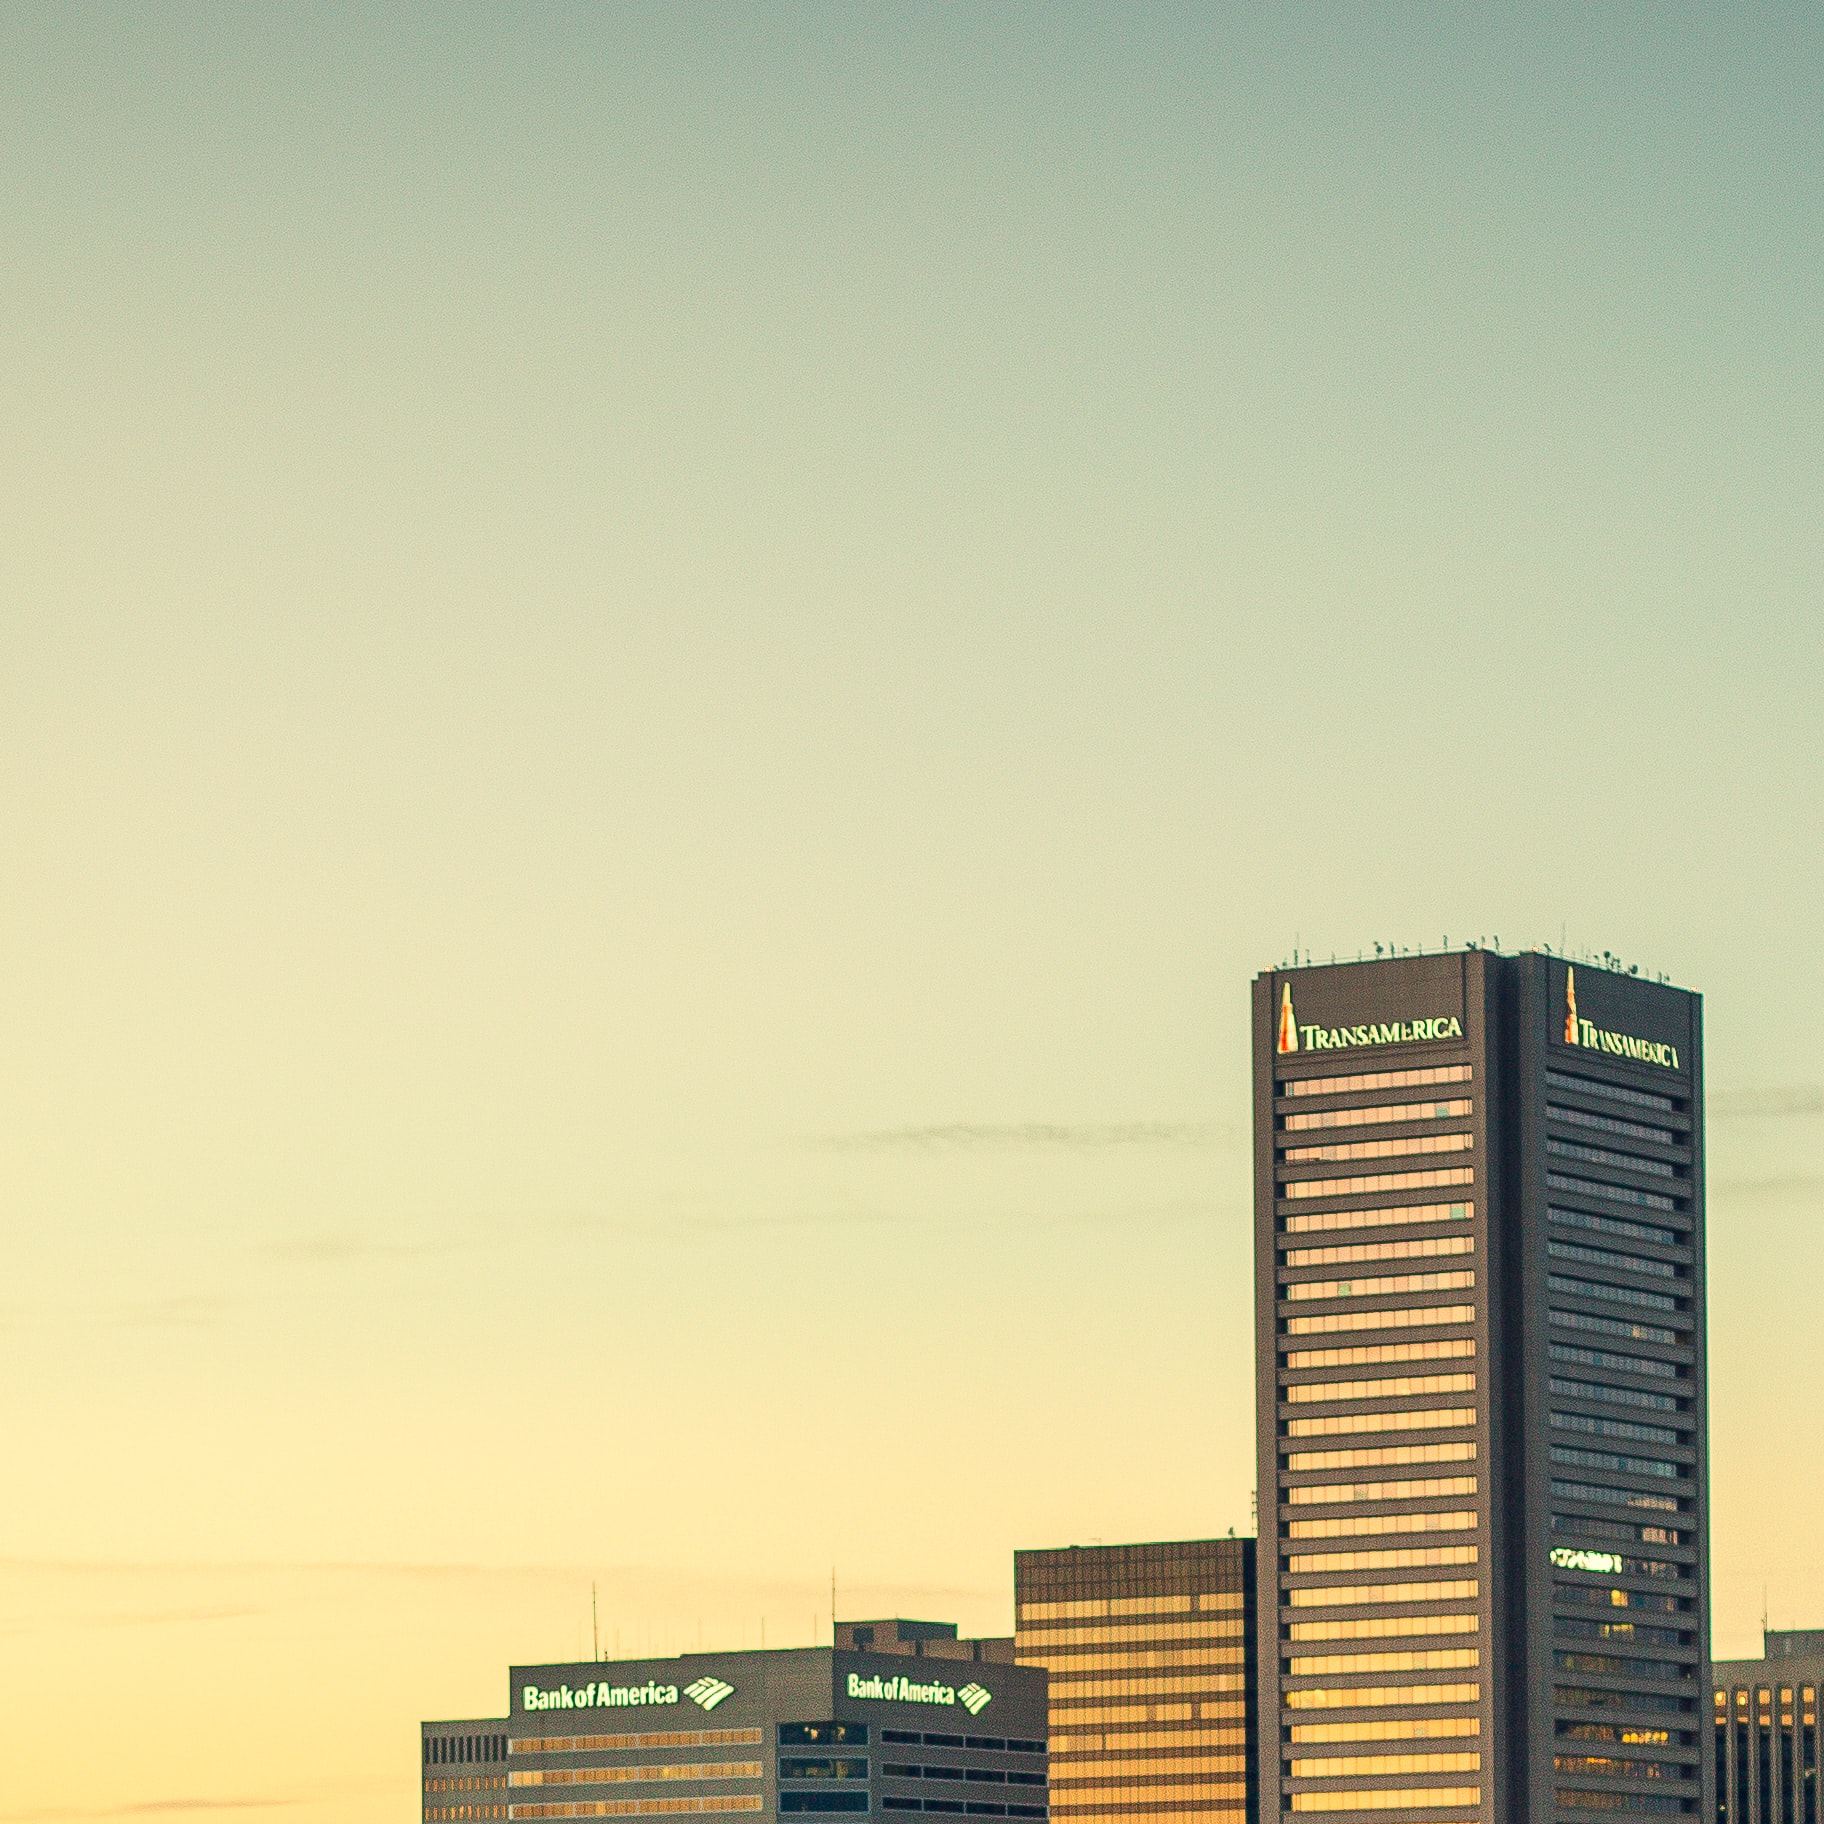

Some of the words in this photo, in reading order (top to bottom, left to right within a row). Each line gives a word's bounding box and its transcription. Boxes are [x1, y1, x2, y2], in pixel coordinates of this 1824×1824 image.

[523, 1684, 574, 1711] Bank
[575, 1682, 596, 1708] of
[596, 1680, 678, 1707] America
[847, 1672, 883, 1699] Bank
[883, 1676, 899, 1700] of
[899, 1676, 955, 1706] America
